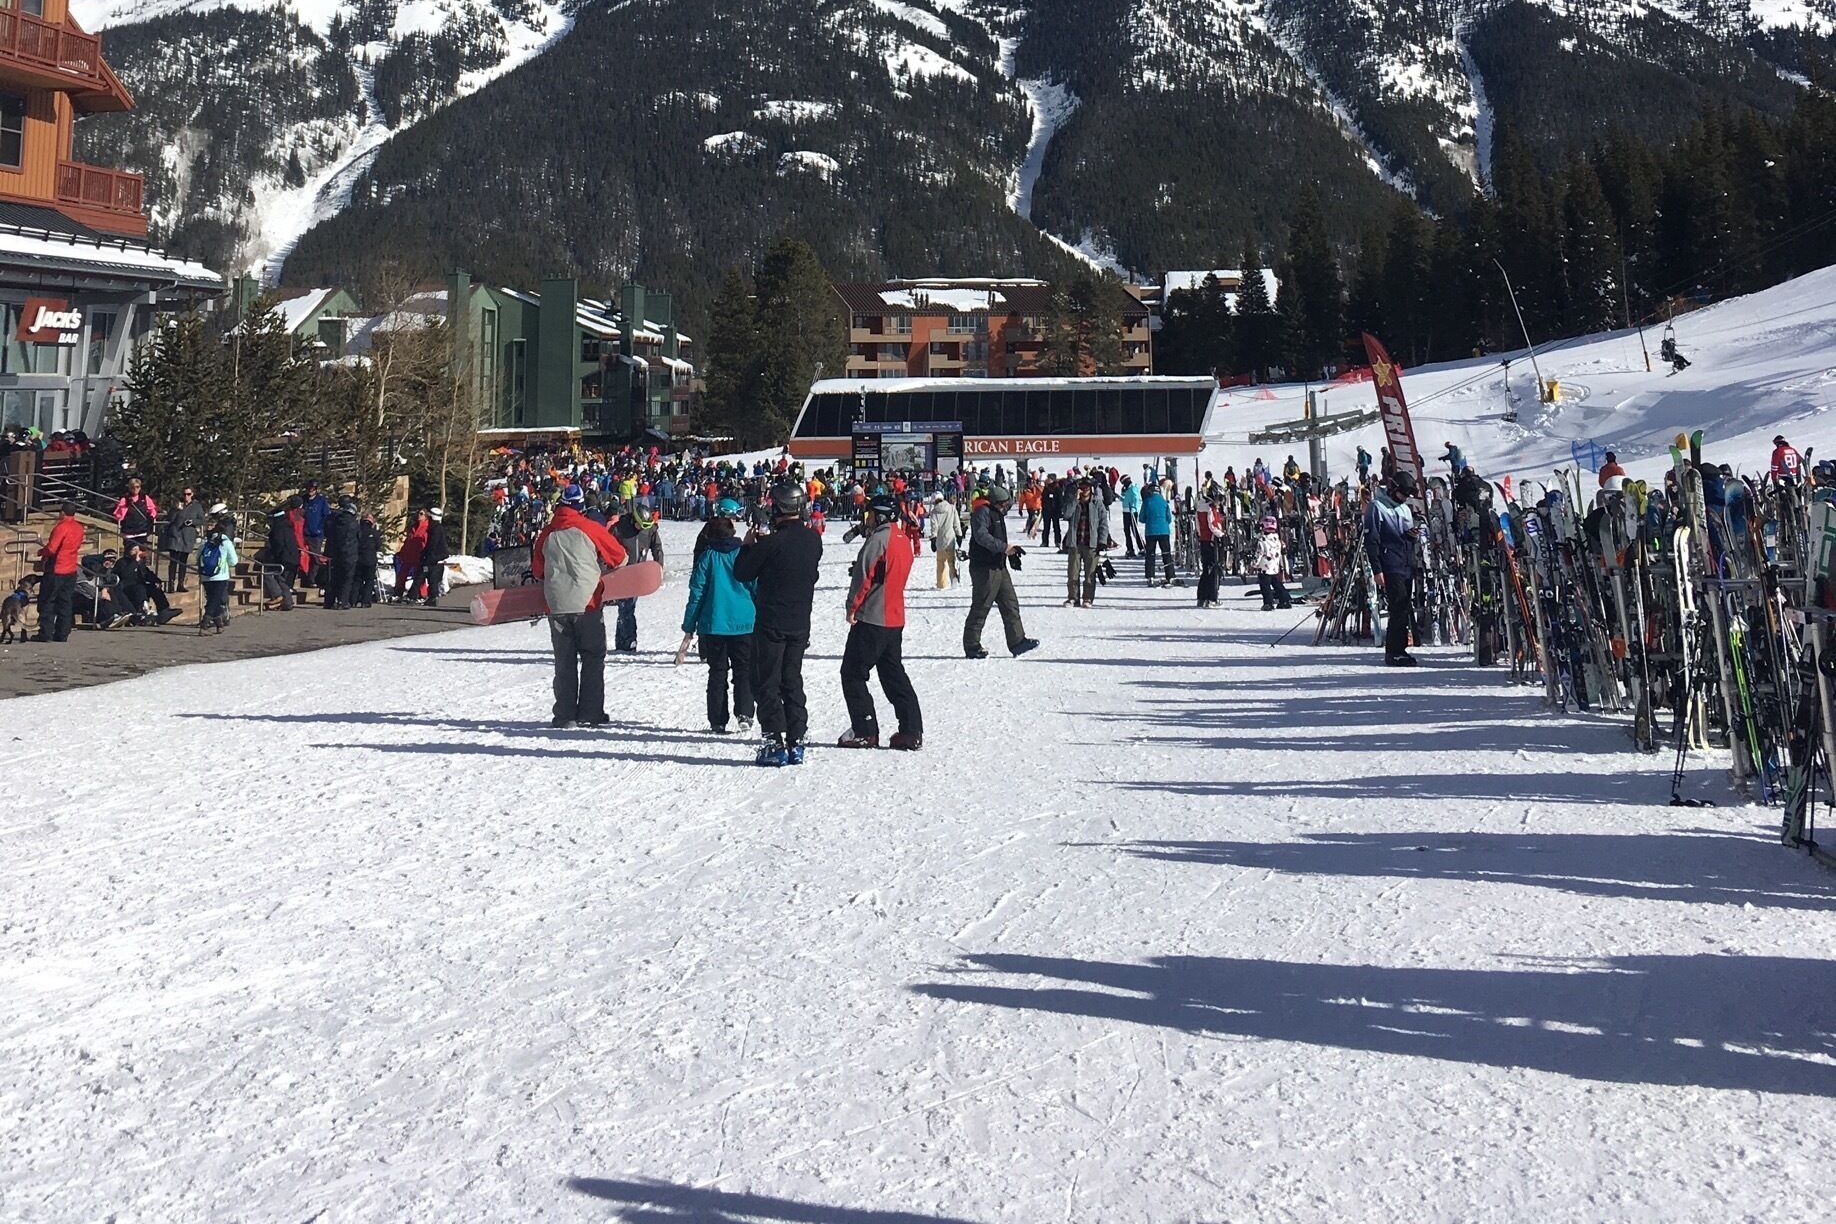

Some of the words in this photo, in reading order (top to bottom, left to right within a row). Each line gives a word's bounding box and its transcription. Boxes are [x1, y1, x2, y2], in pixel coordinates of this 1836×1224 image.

[29, 306, 82, 333] JACK'S
[58, 333, 79, 343] BAR
[963, 440, 1009, 453] RICAN
[1015, 440, 1060, 453] EAGLE
